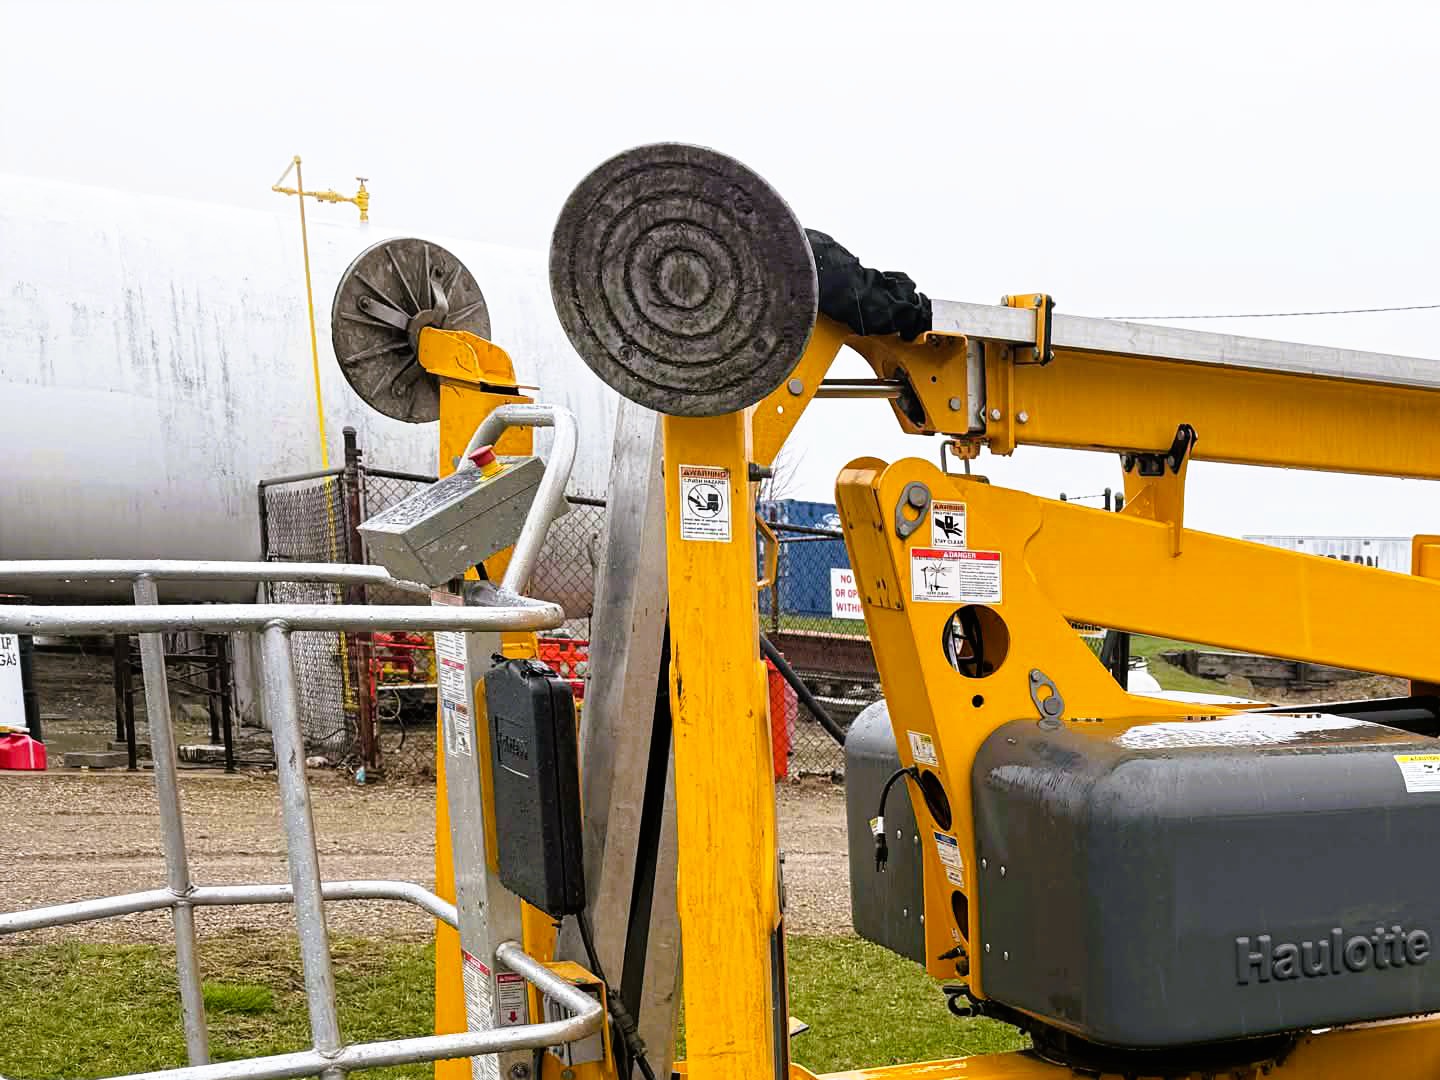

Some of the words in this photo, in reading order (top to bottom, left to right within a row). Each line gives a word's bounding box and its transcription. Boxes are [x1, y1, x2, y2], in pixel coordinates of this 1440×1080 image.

[948, 551, 976, 559] DANGER
[840, 575, 852, 584] NO
[835, 588, 846, 598] OR
[836, 602, 863, 613] WITHI
[0, 653, 17, 666] GAS
[1235, 925, 1431, 986] Haulotte
